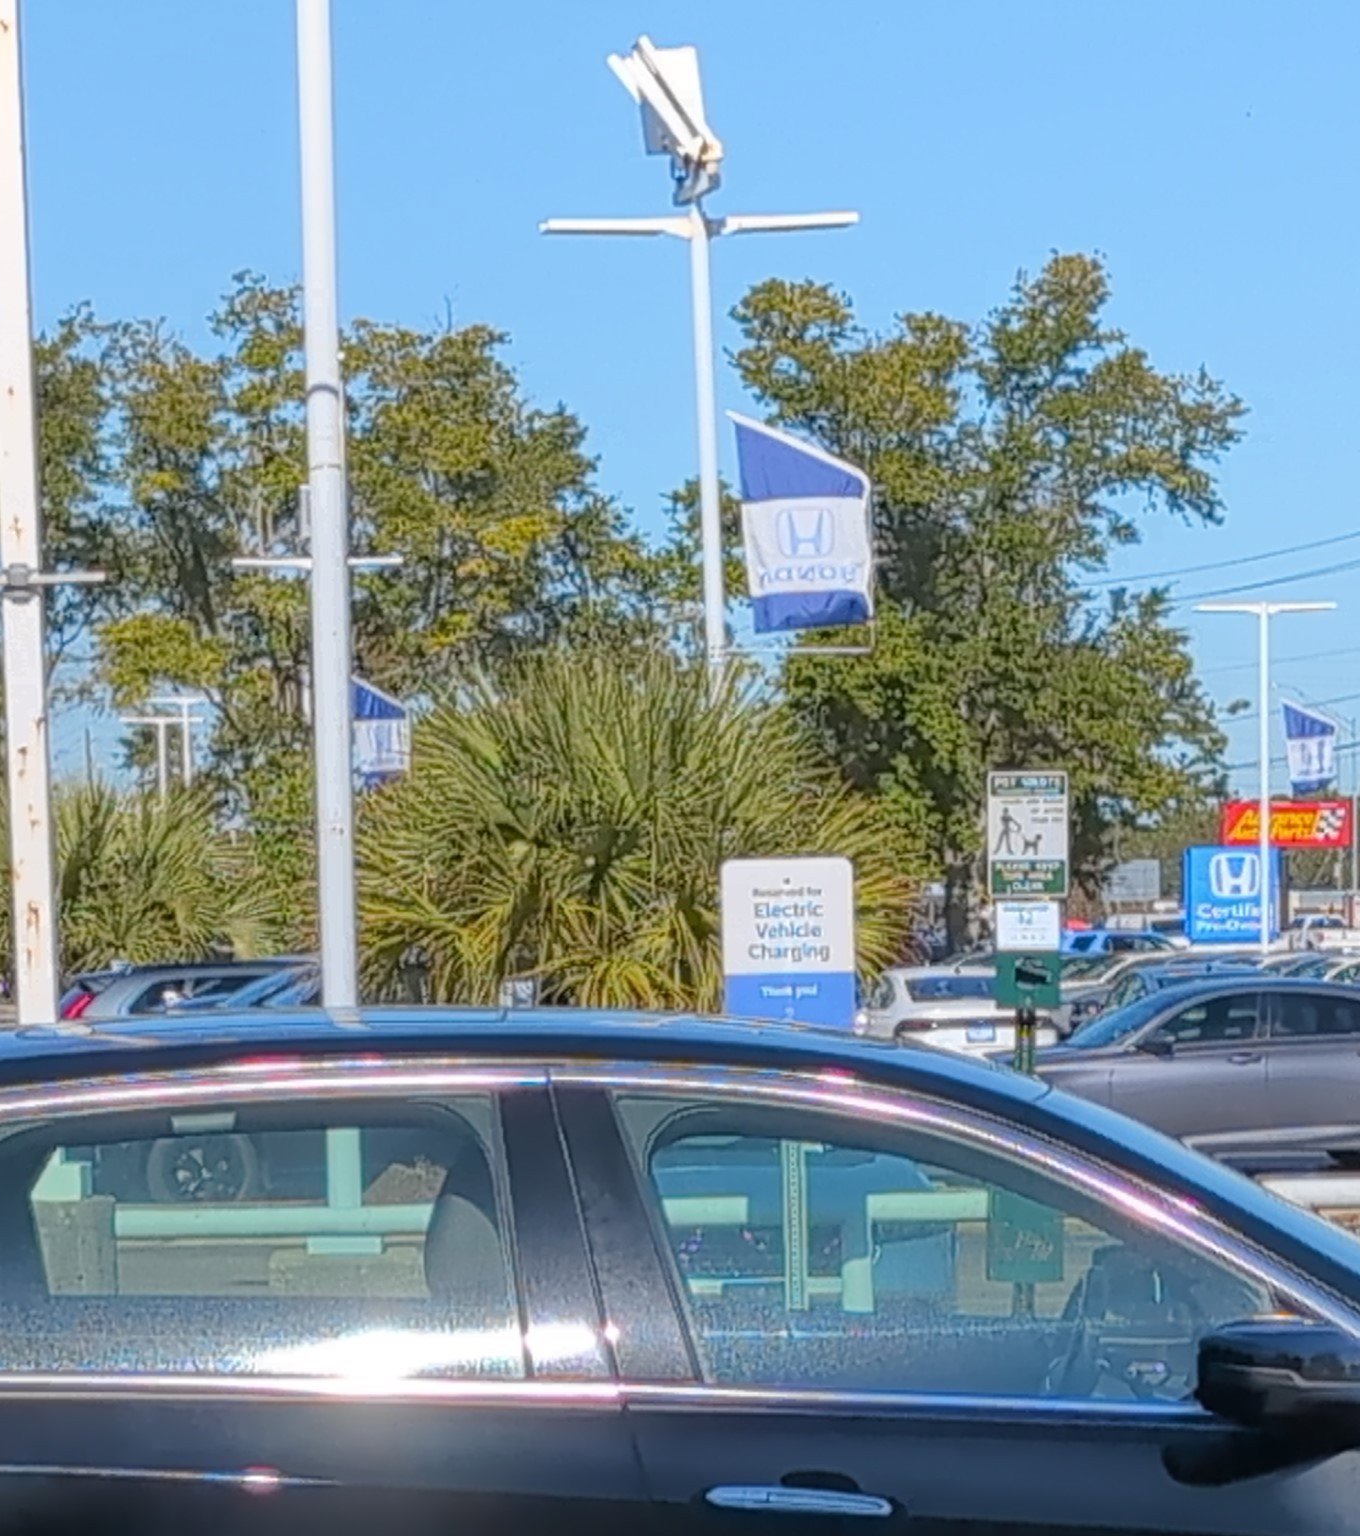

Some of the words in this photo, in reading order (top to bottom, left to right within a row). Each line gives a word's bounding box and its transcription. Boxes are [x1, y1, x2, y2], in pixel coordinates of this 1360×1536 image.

[752, 886, 804, 897] Reserved
[807, 886, 823, 896] for
[753, 901, 824, 918] Electric
[1196, 901, 1274, 919] Certifi
[755, 922, 822, 939] Vehicle
[1196, 918, 1274, 933] Pre-Own
[748, 943, 831, 962] Charging
[760, 985, 792, 997] Thank
